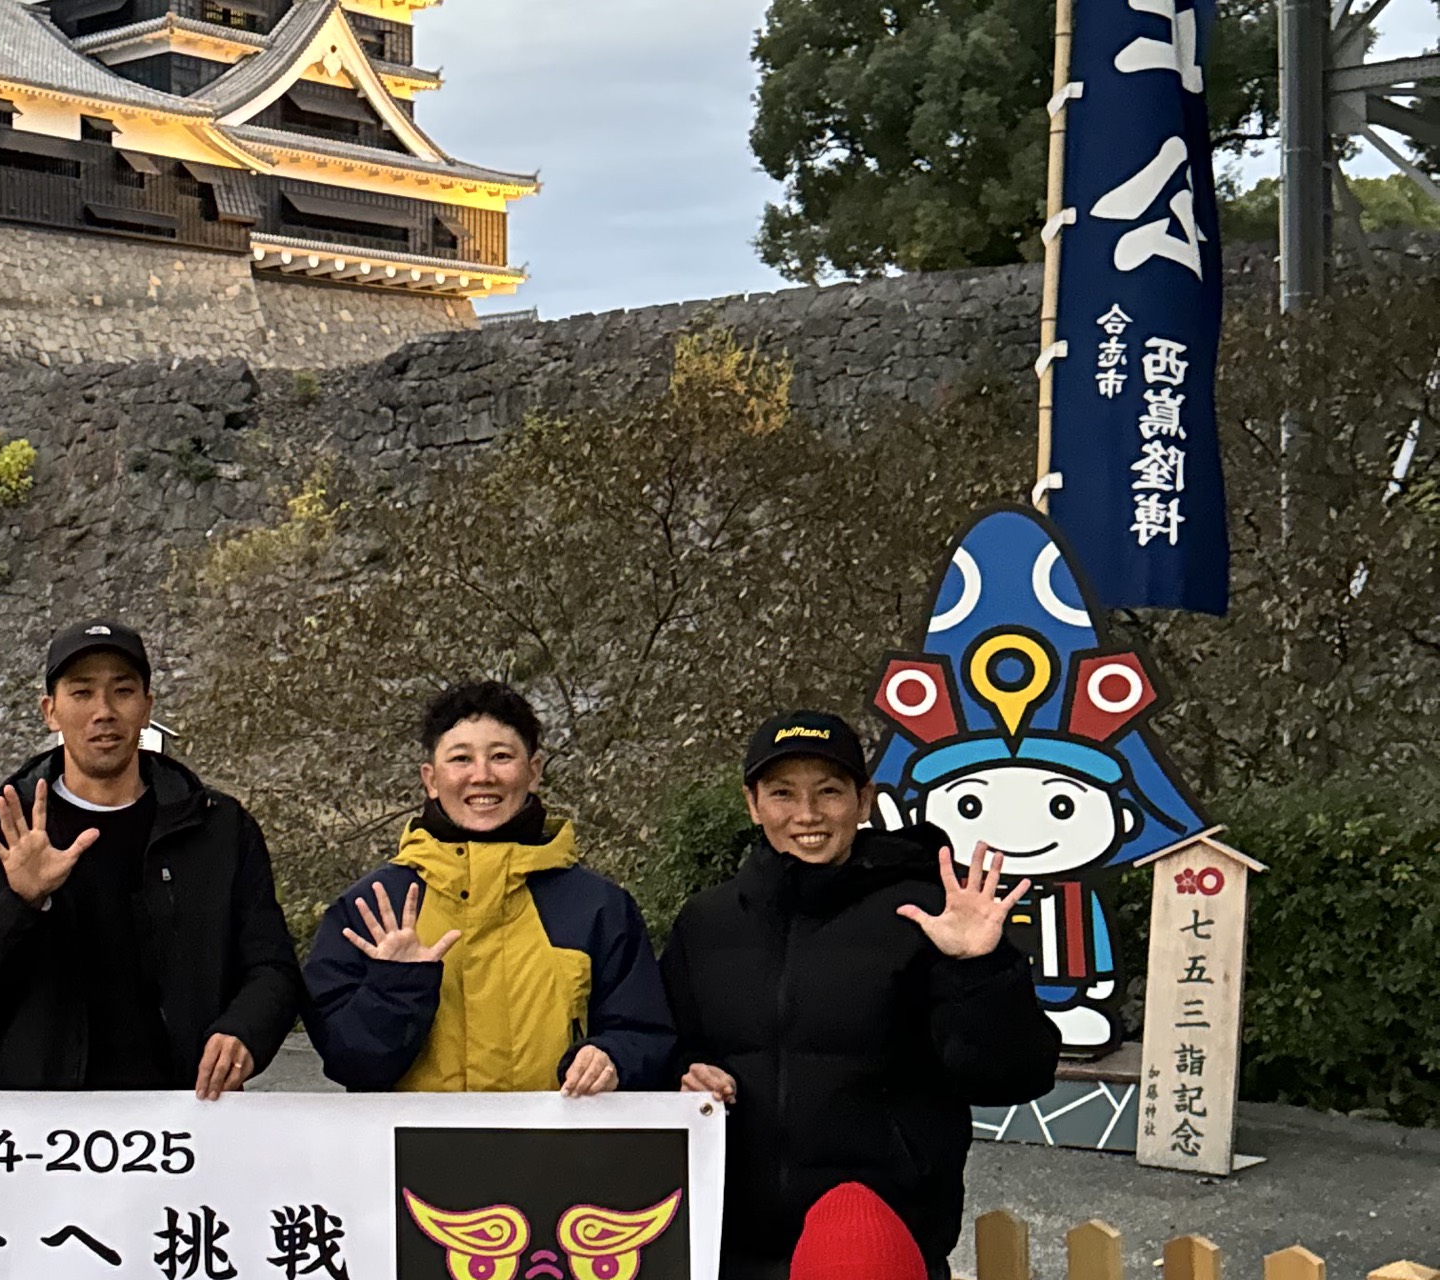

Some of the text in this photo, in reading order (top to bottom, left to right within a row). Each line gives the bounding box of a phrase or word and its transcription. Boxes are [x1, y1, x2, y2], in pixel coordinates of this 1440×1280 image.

[1171, 909, 1215, 1157] 七五三詣記念
